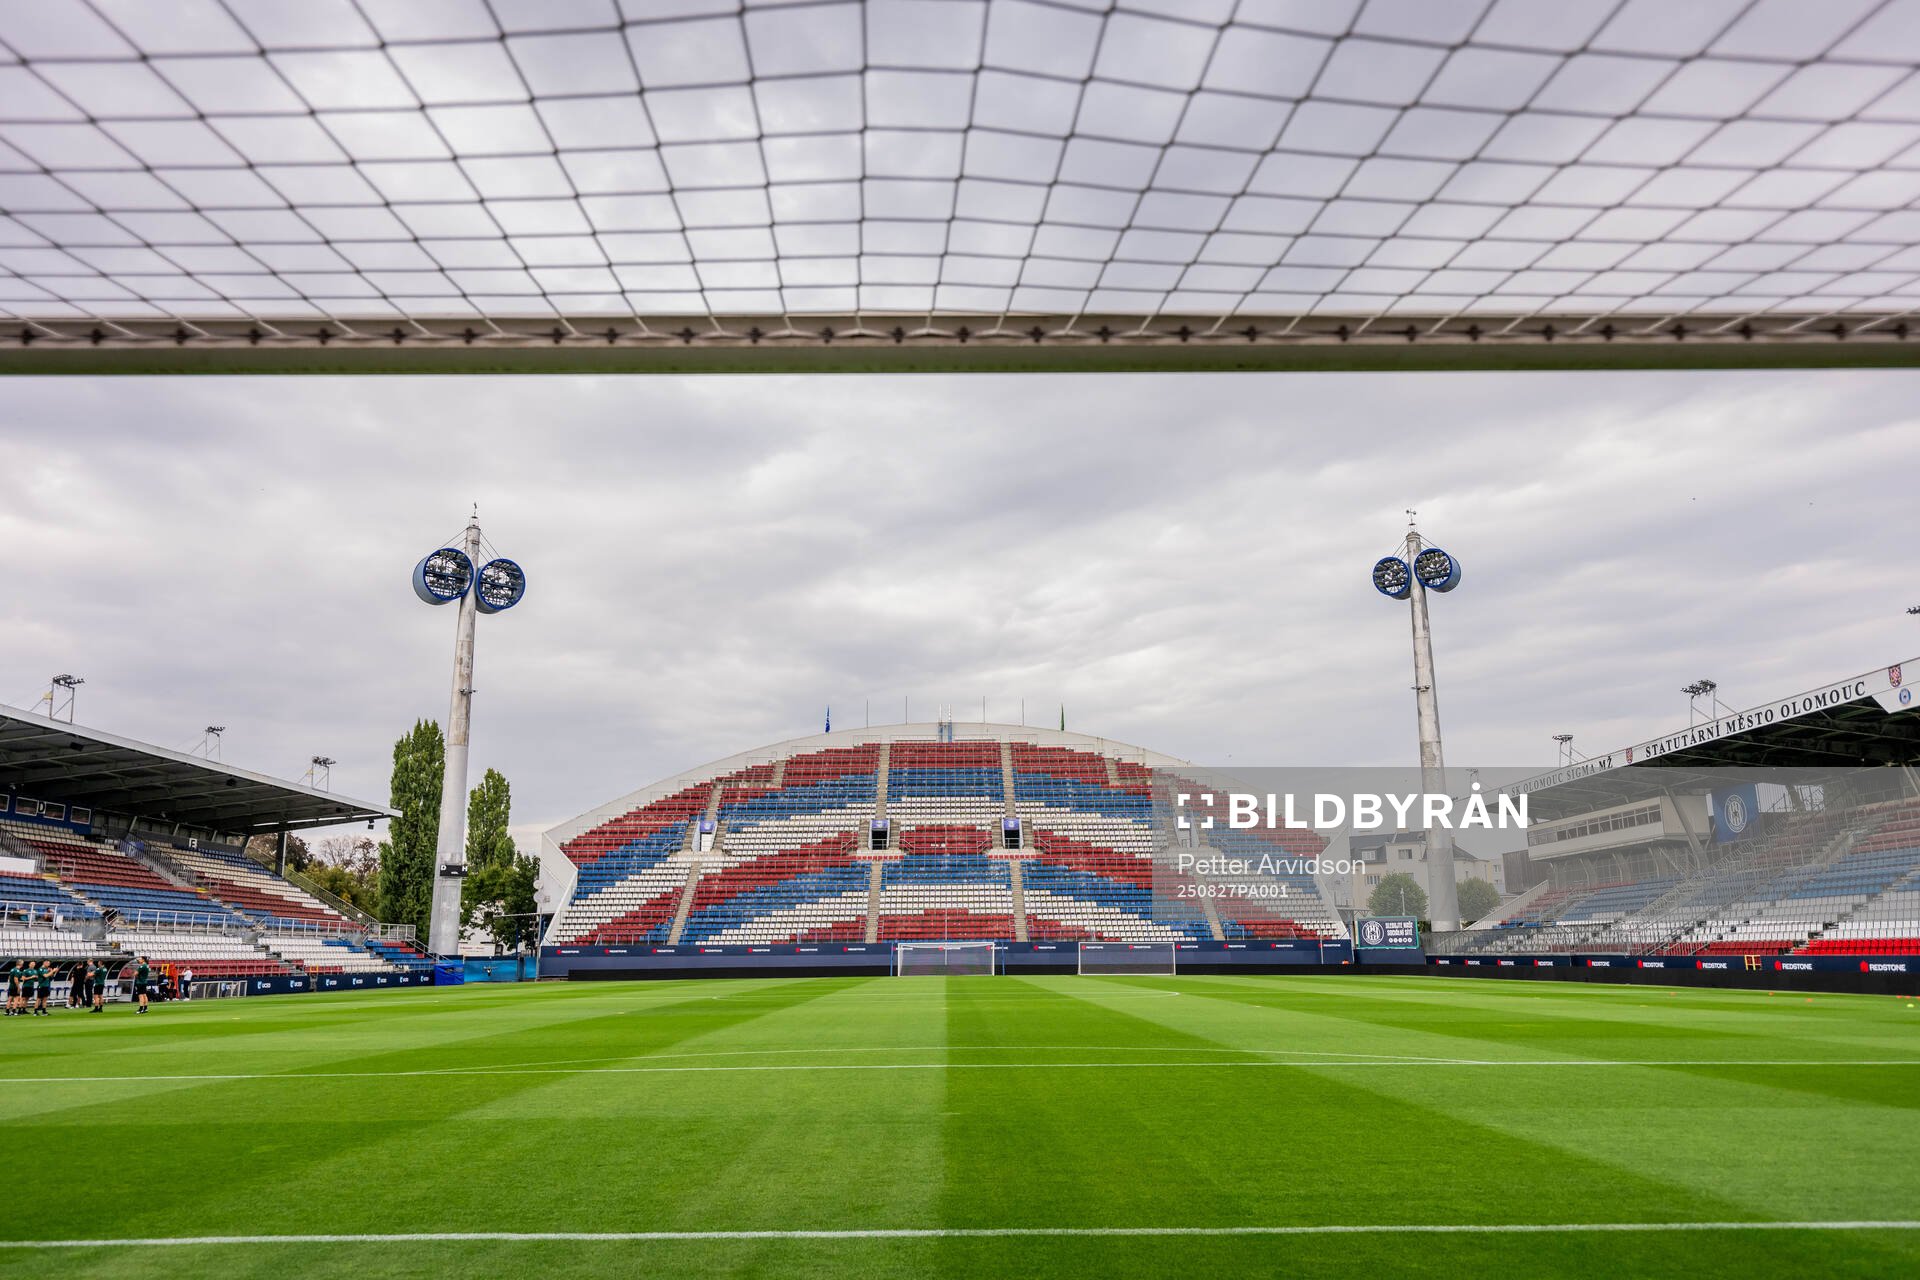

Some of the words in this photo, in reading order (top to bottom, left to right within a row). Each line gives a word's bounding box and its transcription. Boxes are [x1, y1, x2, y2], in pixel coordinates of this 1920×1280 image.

[1645, 721, 1721, 758] STATUTÁRNÍ
[1726, 712, 1774, 734] MĚSTO
[1780, 681, 1866, 717] OLOMOUC
[1511, 786, 1521, 797] SK
[1523, 773, 1564, 792] OLOMOUC
[1566, 764, 1596, 781] SIGMA
[1598, 755, 1613, 771] MŽ
[1869, 964, 1906, 972] REDSTONE
